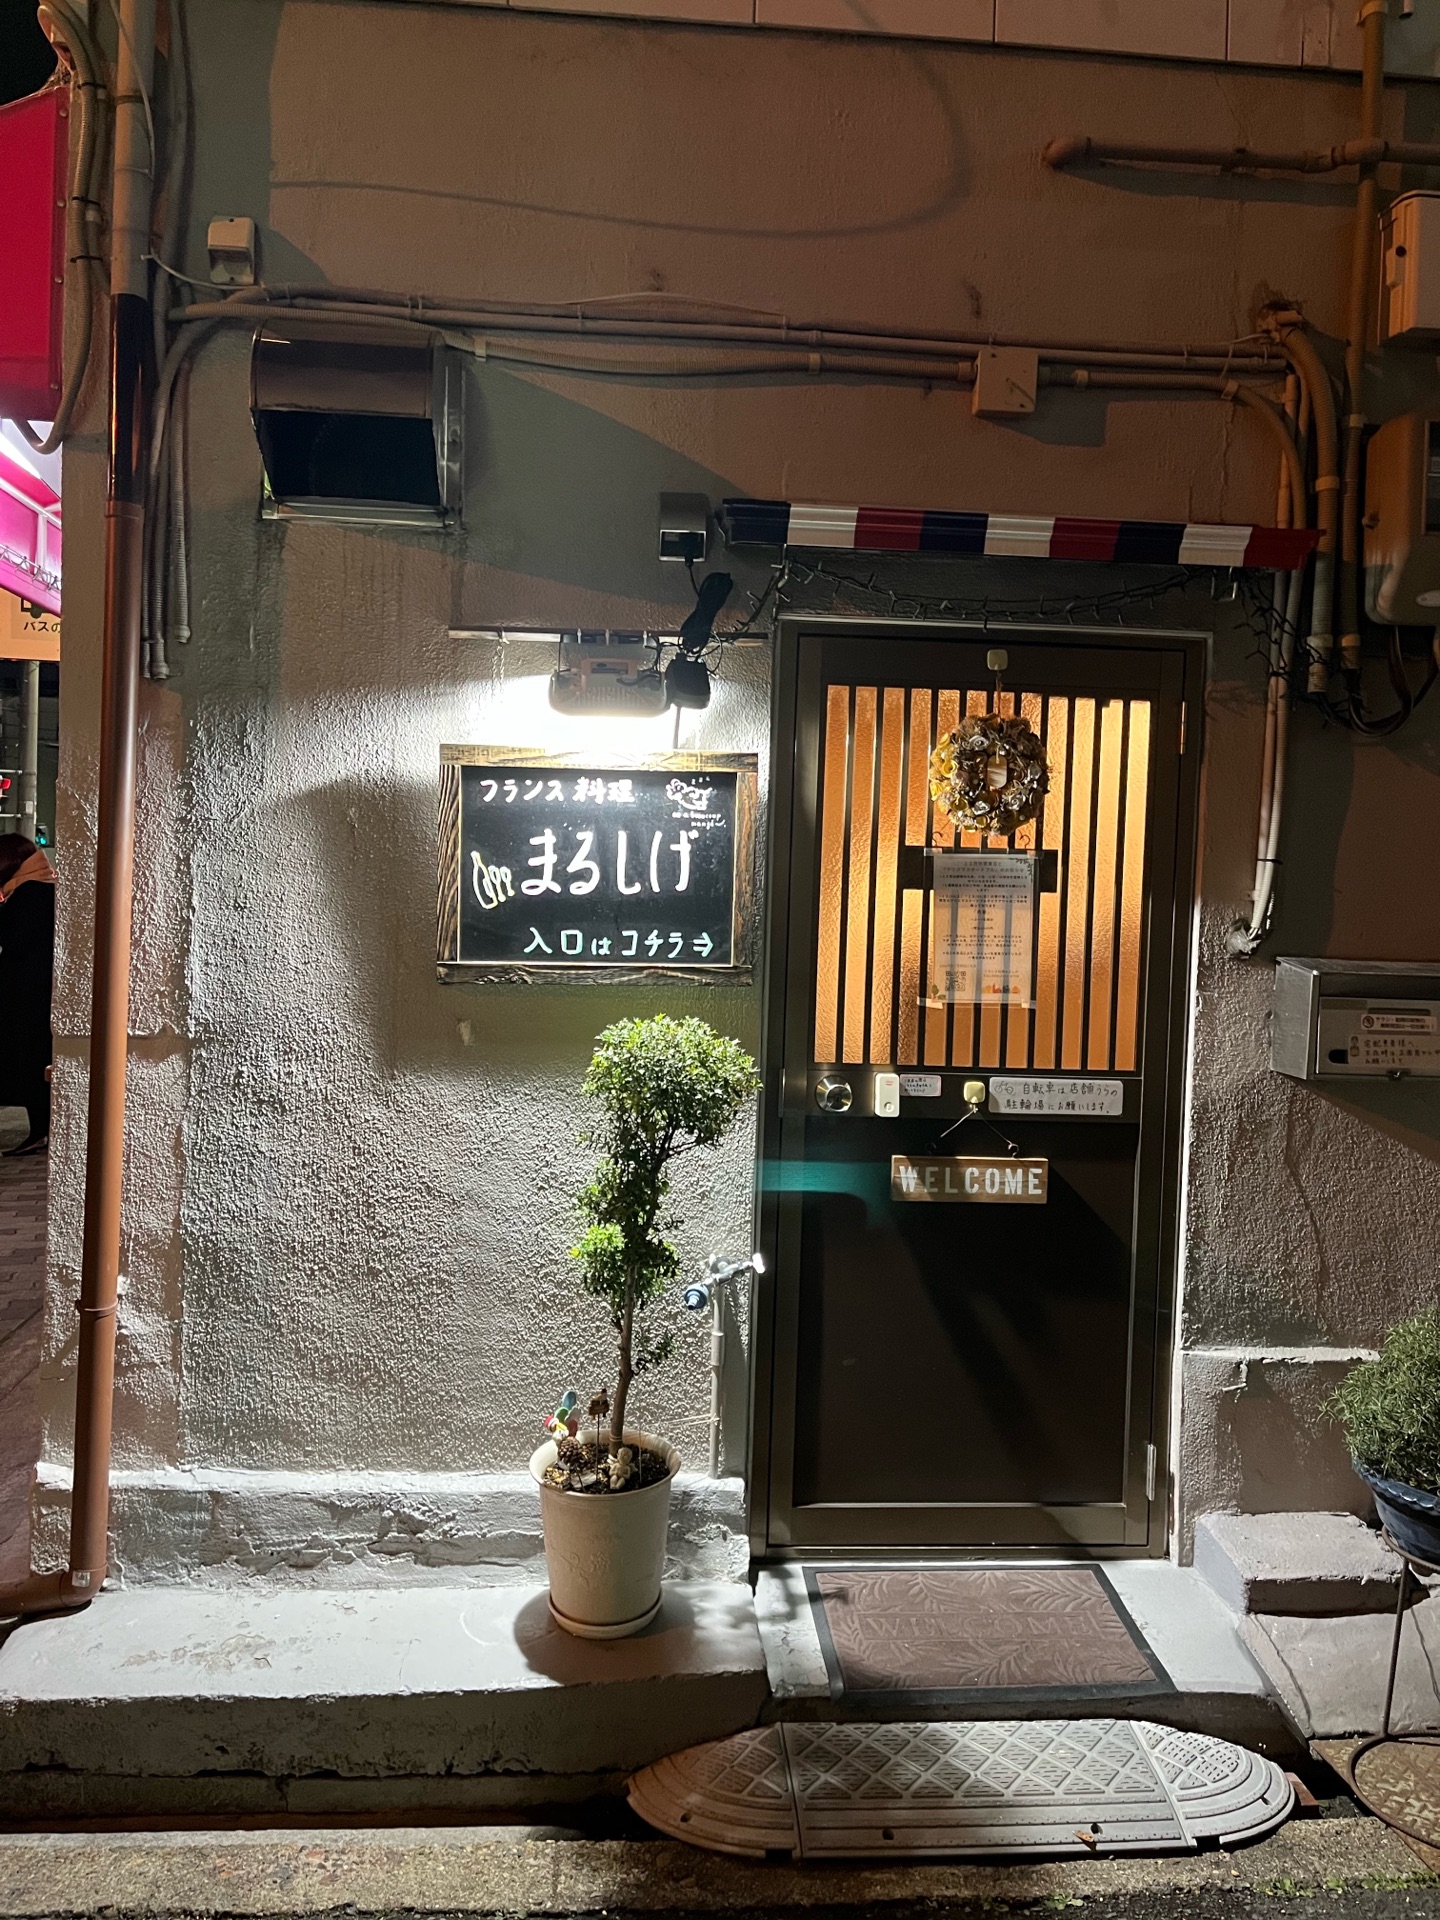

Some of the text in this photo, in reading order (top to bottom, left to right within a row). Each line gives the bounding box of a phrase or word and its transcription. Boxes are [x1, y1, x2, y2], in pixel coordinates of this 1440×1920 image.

[521, 828, 699, 895] まるしげ
[524, 927, 684, 958] 入口はコチラ
[899, 1166, 1043, 1195] WELCOME
